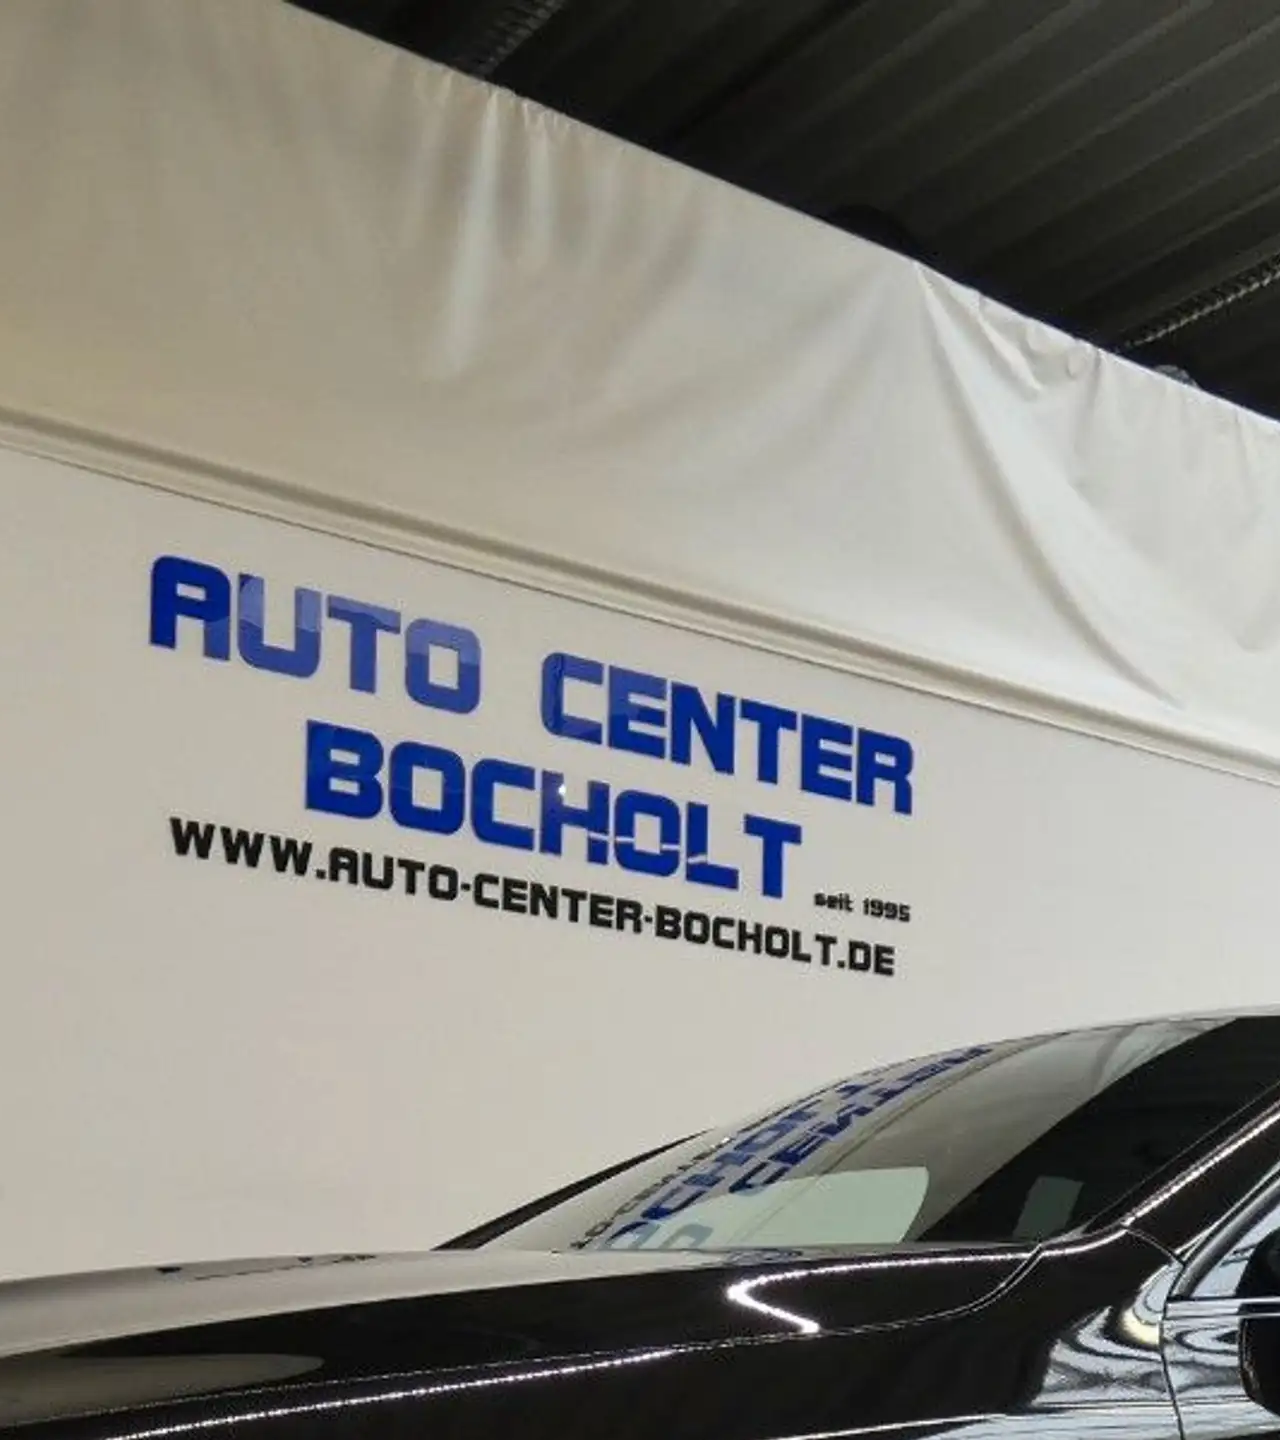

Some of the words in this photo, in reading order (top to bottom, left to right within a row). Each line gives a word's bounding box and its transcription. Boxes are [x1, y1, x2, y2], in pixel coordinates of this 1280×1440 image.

[151, 555, 481, 713] AUTO
[541, 652, 914, 816] CENTER
[304, 719, 803, 899] BOCHOLT
[169, 816, 896, 977] WWW.AUTO-CENTER-BOCHOLT.DE
[814, 892, 854, 913] seit
[863, 897, 911, 923] 1995
